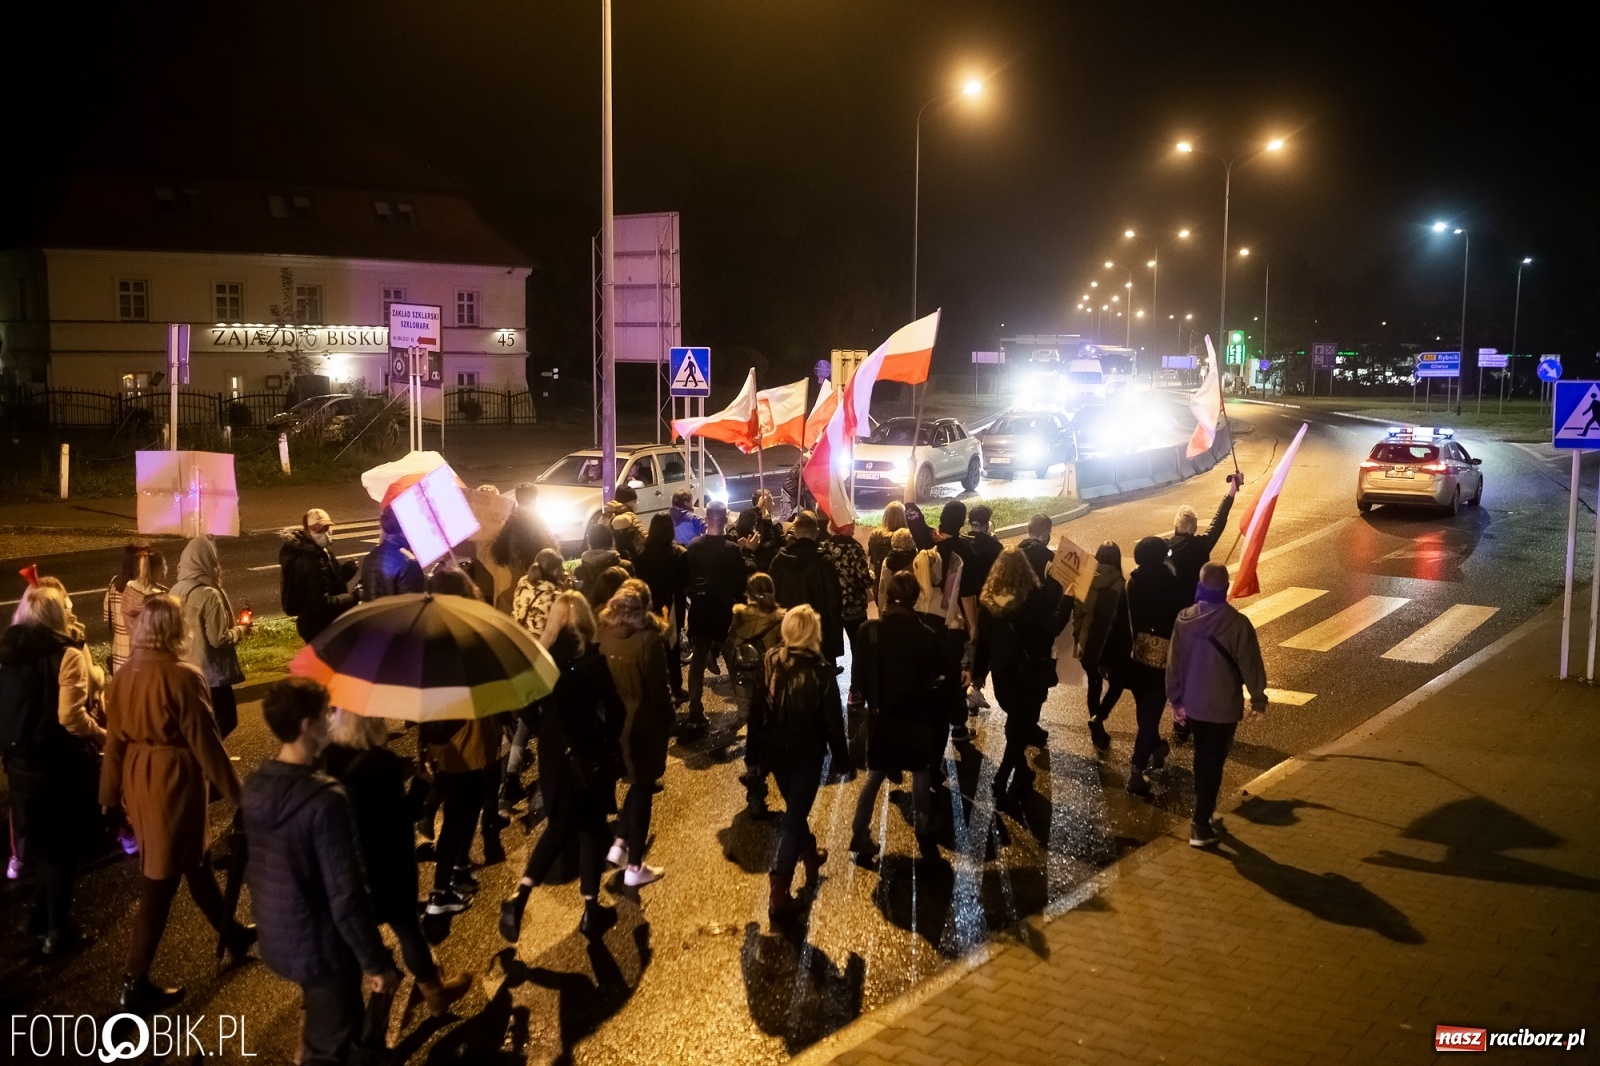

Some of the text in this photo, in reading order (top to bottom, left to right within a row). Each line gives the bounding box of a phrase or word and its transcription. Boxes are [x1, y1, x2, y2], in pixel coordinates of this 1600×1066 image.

[392, 309, 439, 321] ZAKŁAD SZKLARSKI
[400, 320, 430, 330] SZKŁOMARK
[212, 329, 295, 349] ZAJAZD
[326, 331, 389, 346] BISKU
[497, 333, 515, 347] 45
[1438, 354, 1459, 362] Rybnik
